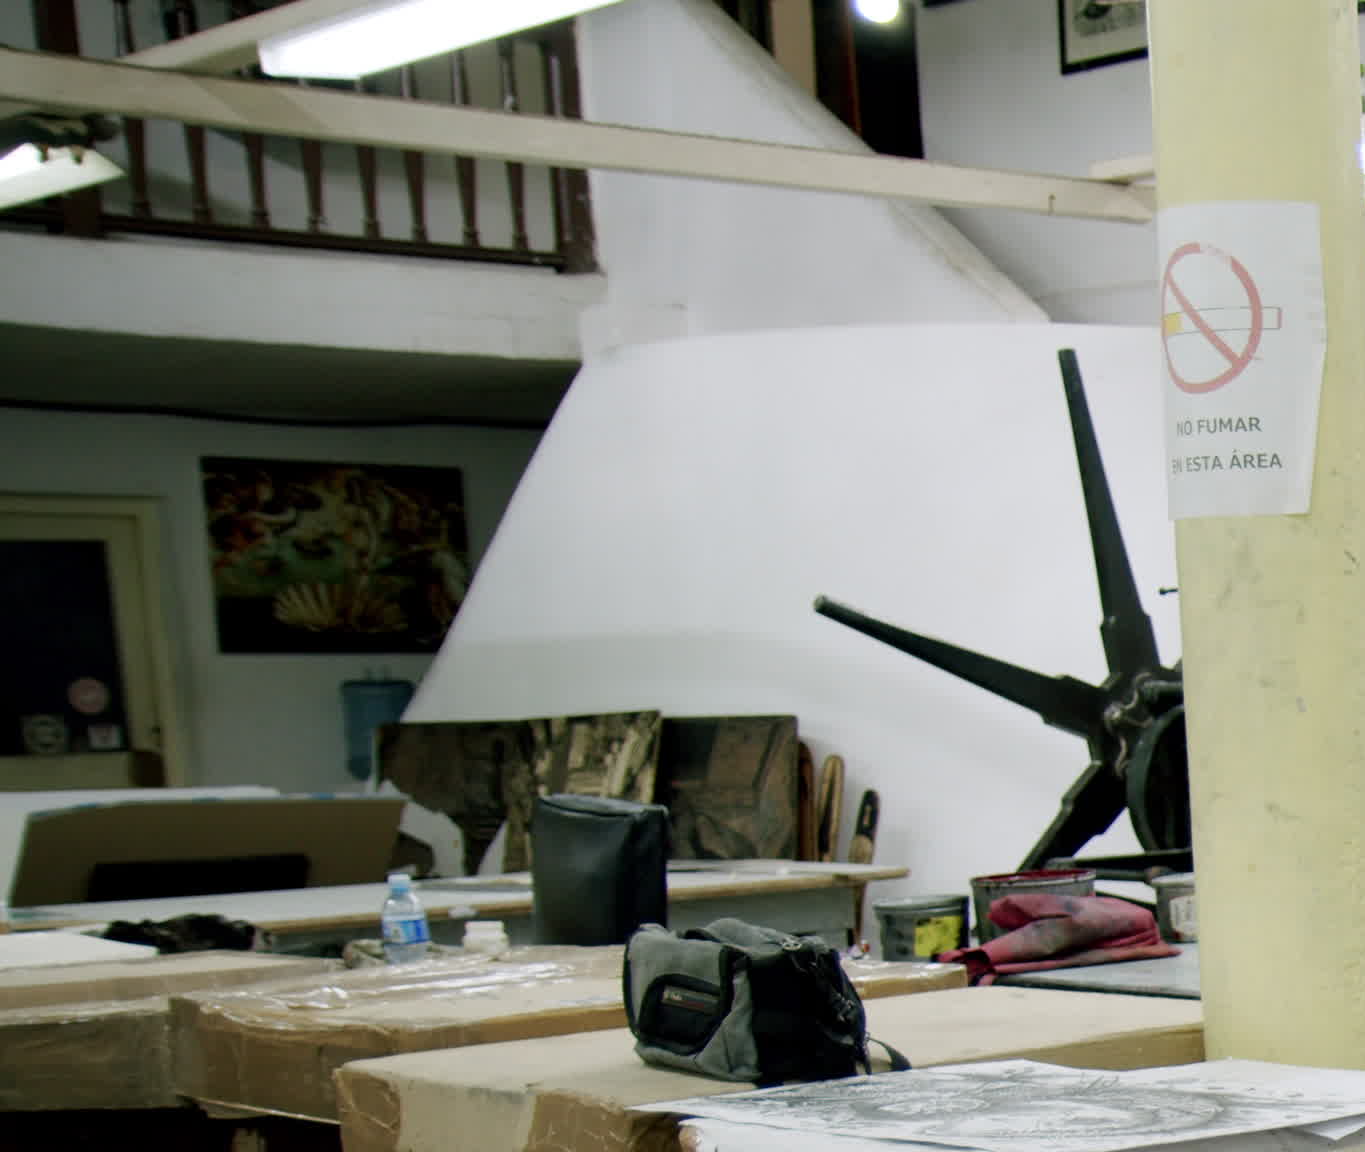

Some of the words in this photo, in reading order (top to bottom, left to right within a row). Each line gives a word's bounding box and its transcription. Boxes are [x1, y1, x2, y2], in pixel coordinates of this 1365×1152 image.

[1176, 420, 1193, 437] NO
[1197, 416, 1262, 434] FUMAR
[1186, 455, 1225, 472] ESTA
[1230, 448, 1283, 470] ÁREA
